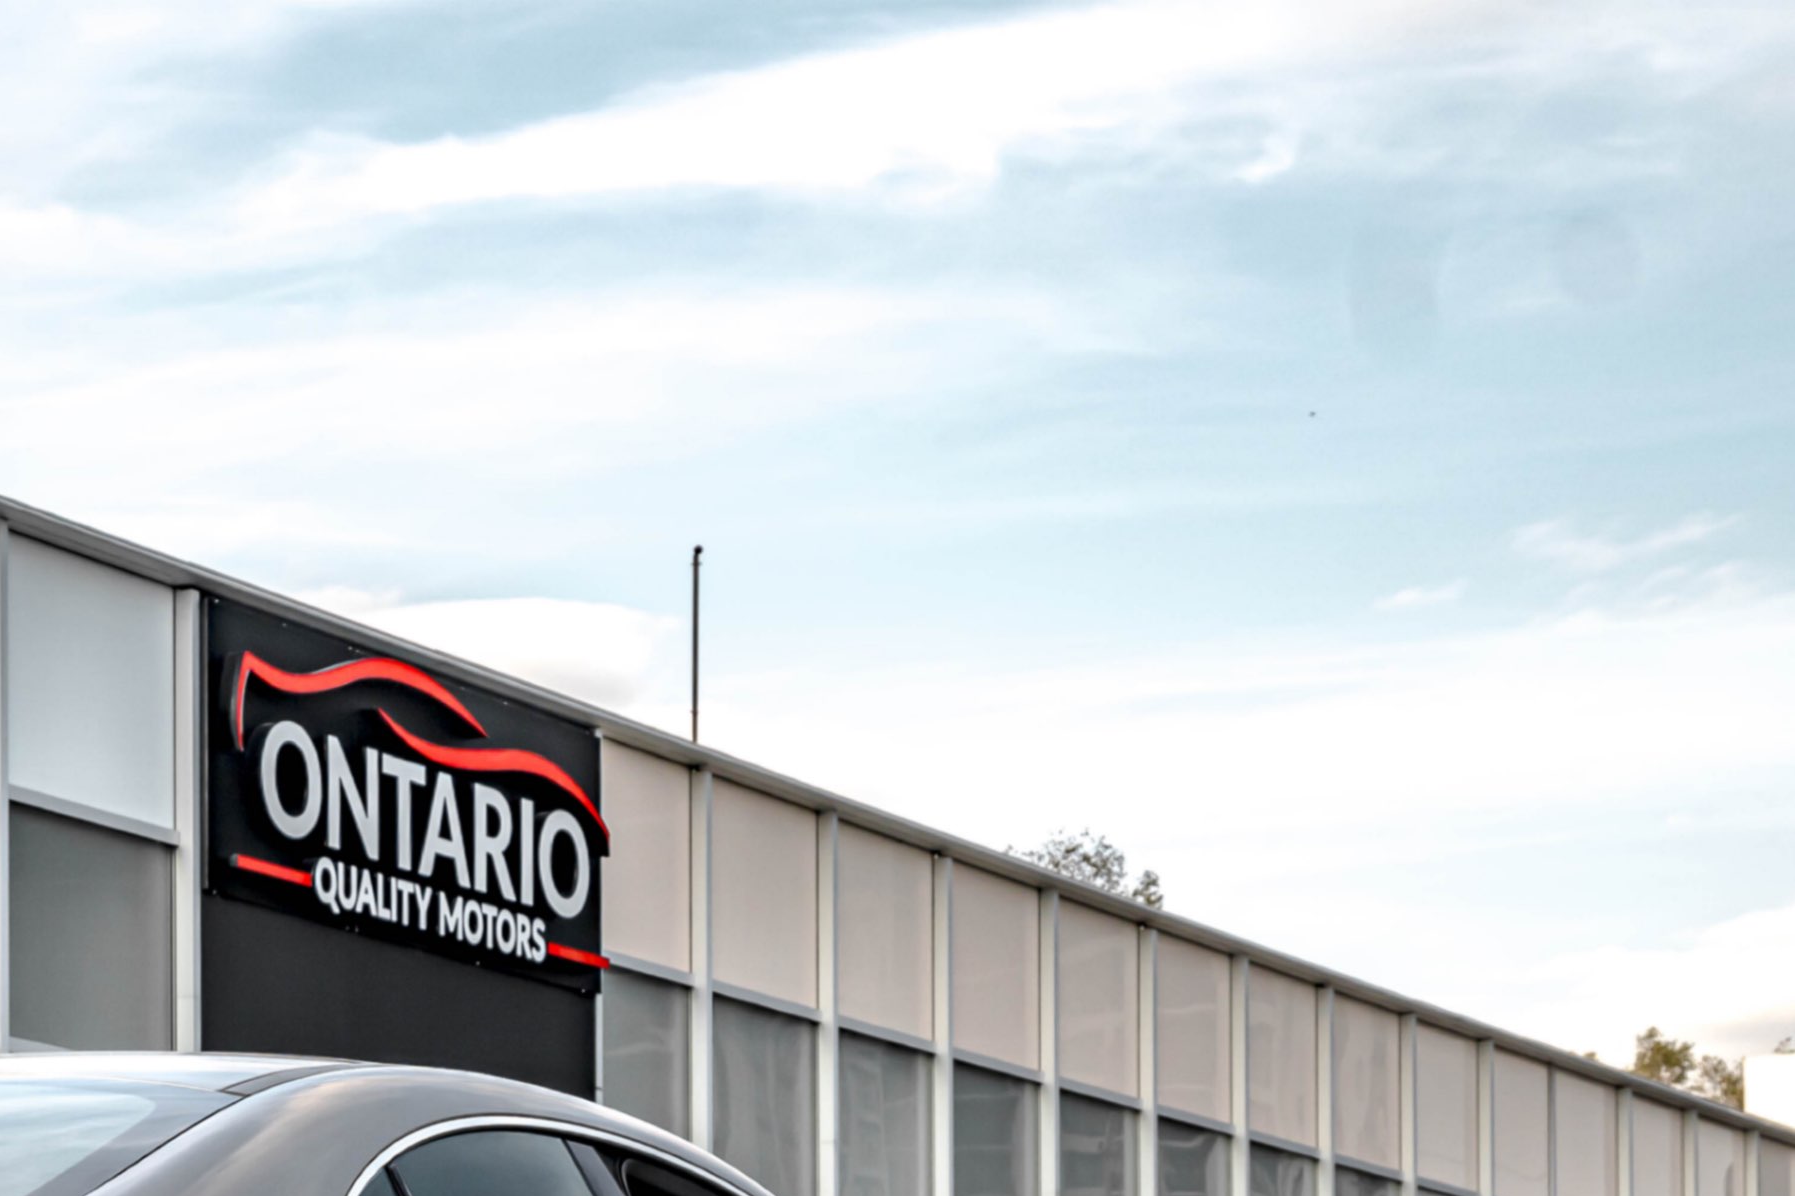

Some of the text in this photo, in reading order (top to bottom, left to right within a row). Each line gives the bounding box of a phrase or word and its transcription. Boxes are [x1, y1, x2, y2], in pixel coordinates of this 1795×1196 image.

[260, 720, 590, 919] ONTARIO
[314, 856, 547, 963] QUALITY MOTORS
